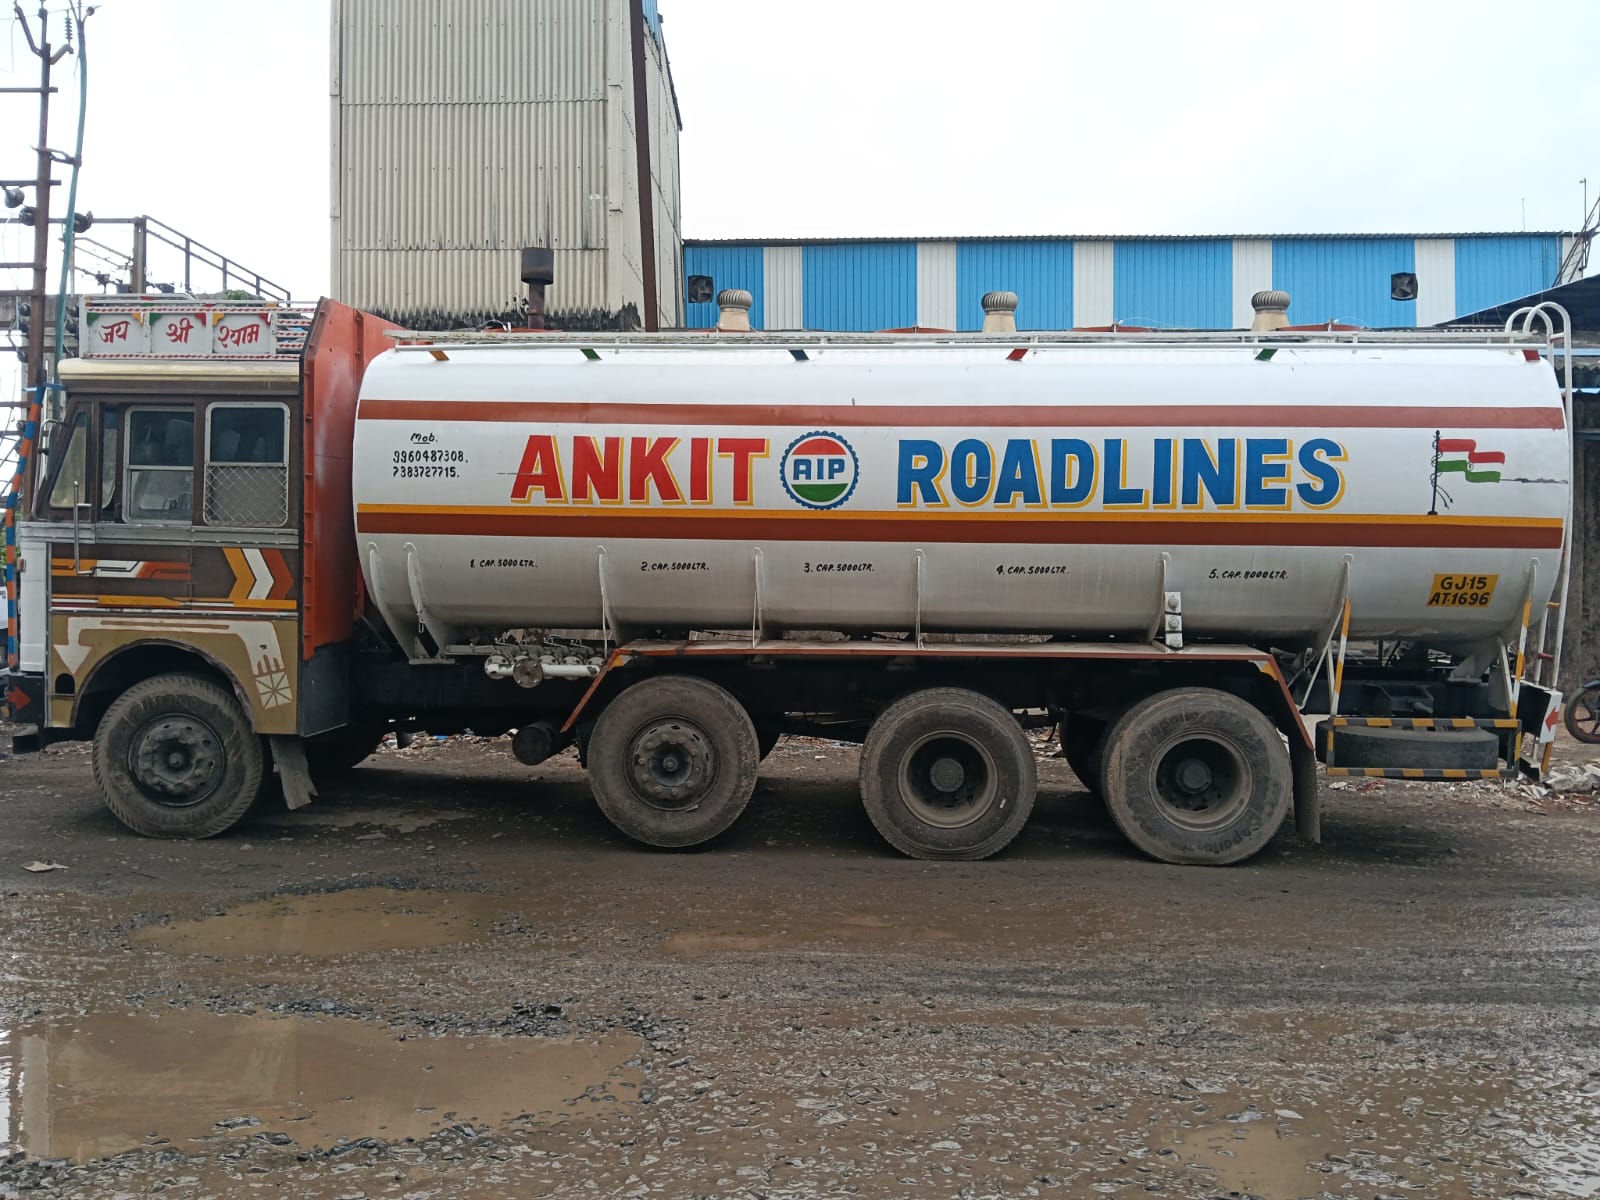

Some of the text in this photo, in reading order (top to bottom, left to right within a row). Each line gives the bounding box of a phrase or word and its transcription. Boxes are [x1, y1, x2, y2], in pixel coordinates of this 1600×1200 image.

[99, 317, 260, 348] जय श्री श्याम
[410, 432, 438, 445] Mob.
[393, 450, 469, 463] 9960487308.
[393, 466, 460, 478] 7383727715.
[510, 434, 1349, 512] ANKIT ROADLINES
[793, 459, 846, 480] AIP
[803, 562, 813, 573] 3.
